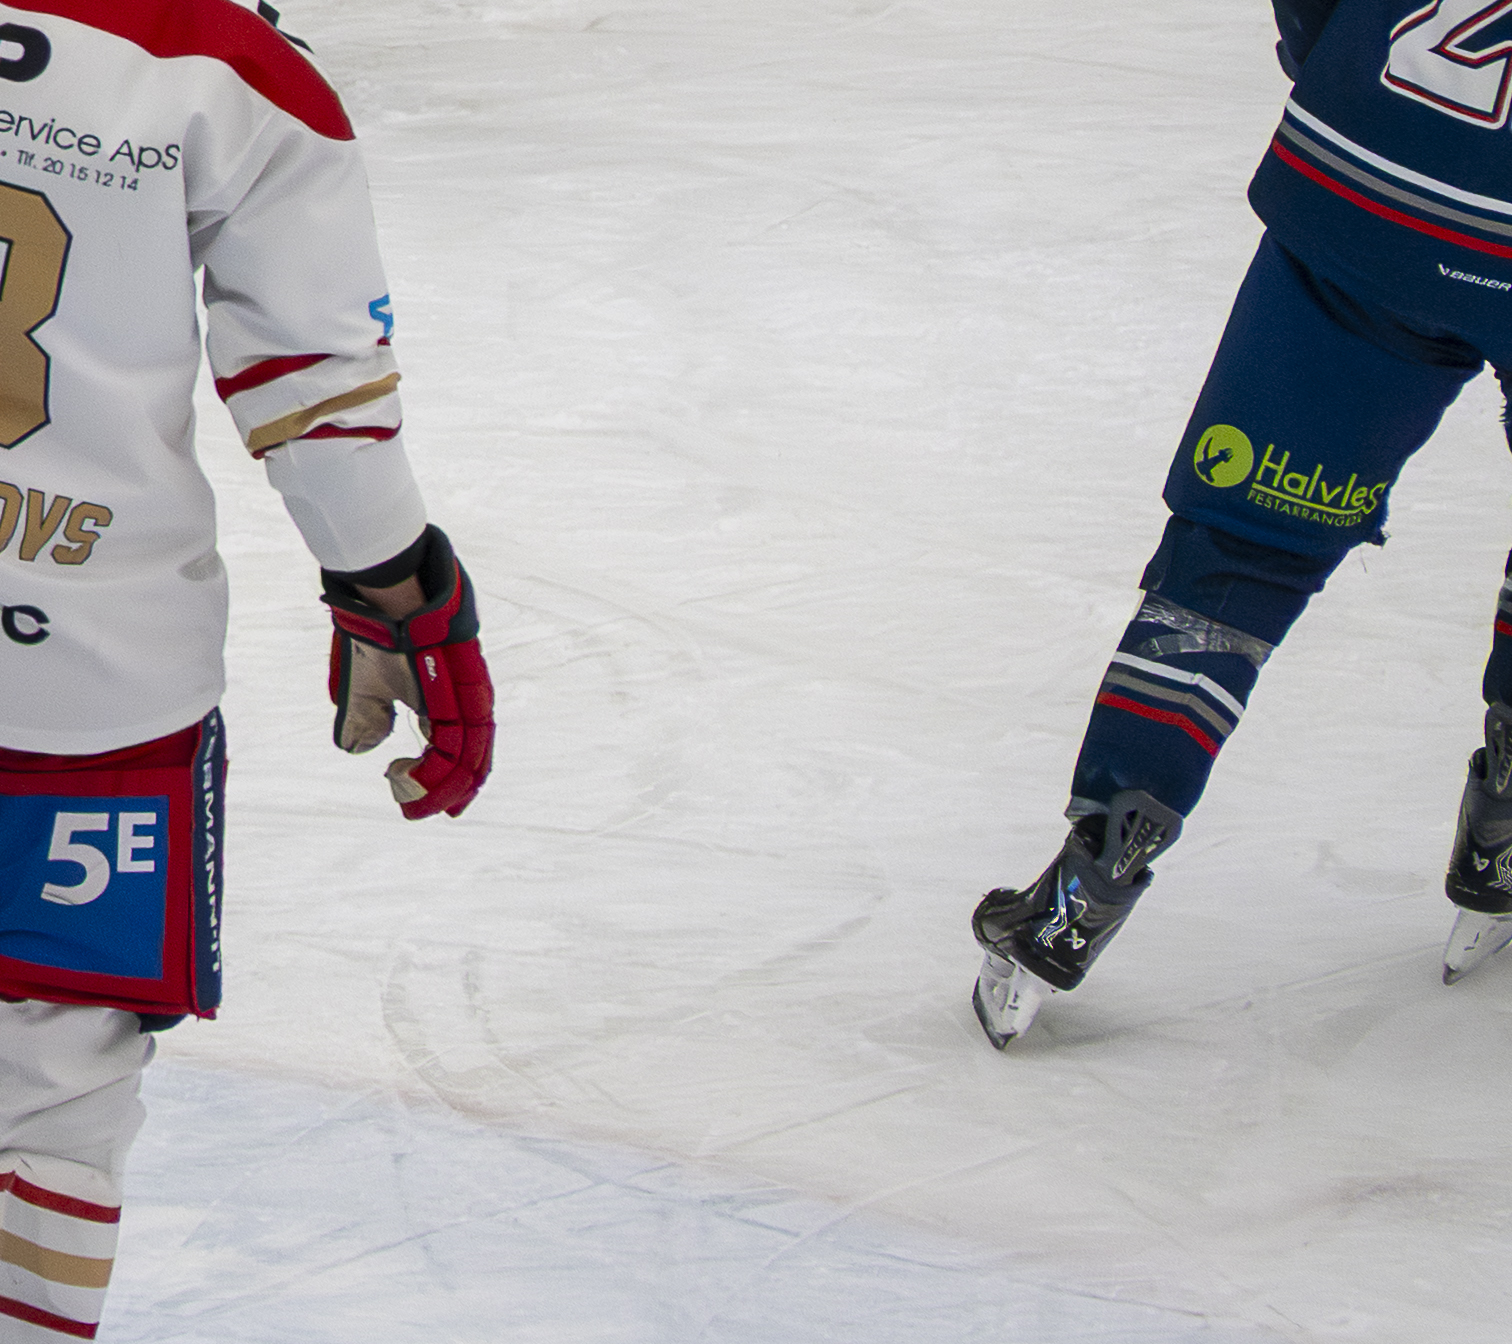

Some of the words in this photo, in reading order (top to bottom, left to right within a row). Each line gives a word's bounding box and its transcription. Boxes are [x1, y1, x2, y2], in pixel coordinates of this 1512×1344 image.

[42, 156, 63, 174] 20
[68, 163, 89, 182] 15
[94, 169, 114, 187] 12
[119, 175, 140, 193] 14
[109, 139, 182, 174] ApS
[40, 811, 158, 907] 5E
